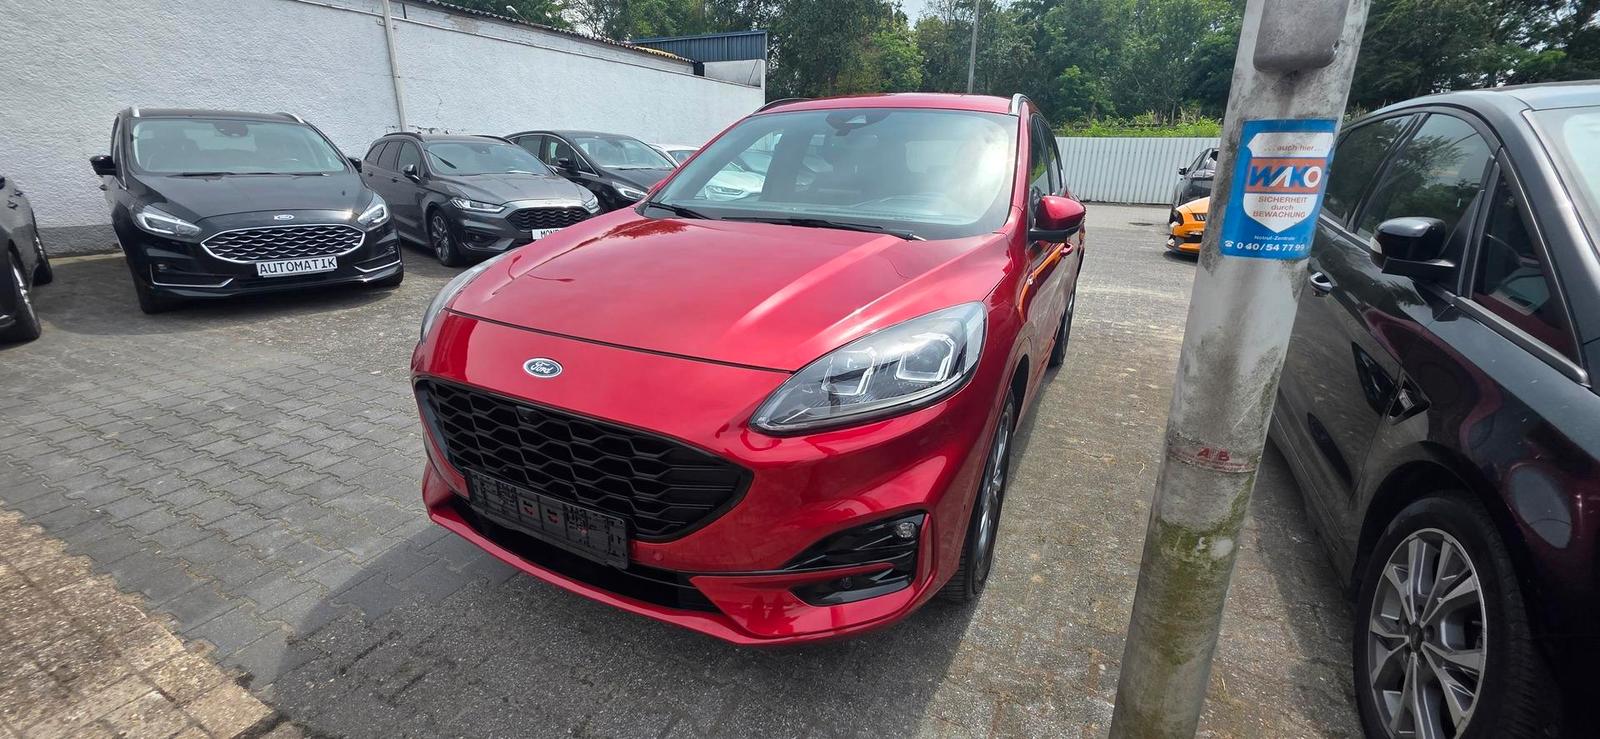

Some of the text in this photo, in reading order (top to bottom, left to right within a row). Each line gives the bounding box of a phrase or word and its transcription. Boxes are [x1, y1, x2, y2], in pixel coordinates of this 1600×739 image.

[1248, 166, 1322, 188] WAKO
[1258, 196, 1307, 204] SICHERHEIT
[259, 257, 336, 274] AUTOMATIK
